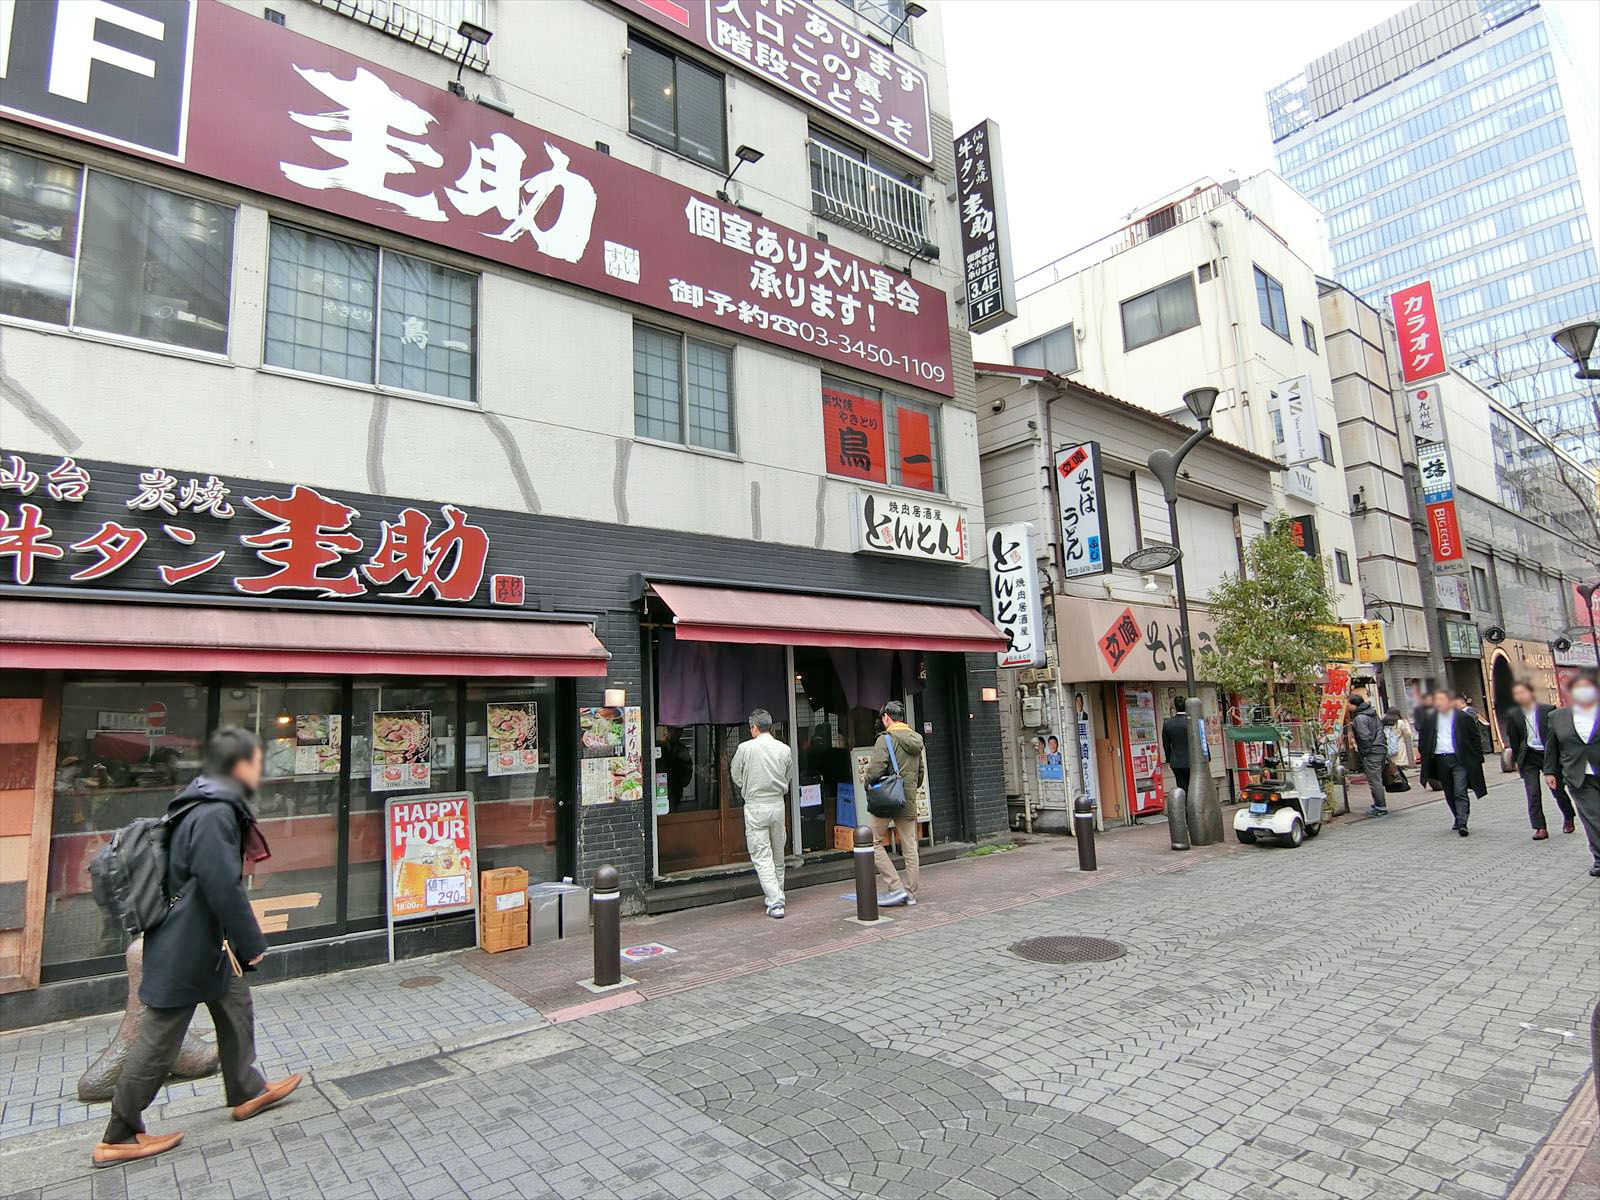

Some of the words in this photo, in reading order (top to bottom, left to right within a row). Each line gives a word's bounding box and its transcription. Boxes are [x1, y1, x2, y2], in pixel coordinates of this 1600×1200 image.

[716, 18, 913, 144] 階段でどうぞ
[279, 62, 598, 264] 圭助
[958, 137, 974, 195] 牛タン
[685, 196, 920, 316] 個室あり大小宴会
[323, 301, 373, 322] やきとり
[750, 261, 876, 332] 承ります!
[970, 274, 998, 299] 3.4F
[976, 297, 995, 318] 1F
[668, 278, 769, 331] 御予約
[799, 322, 946, 383] 03-3450-1109
[1402, 296, 1434, 371] カラオケ
[839, 411, 878, 430] やきとり
[1417, 402, 1434, 430] 九州桜
[127, 468, 236, 519] 炭焼
[888, 501, 943, 521] 焼肉居酒屋
[1076, 468, 1096, 516] そば
[0, 503, 226, 586] 牛タン
[234, 485, 490, 601] 圭助
[1063, 507, 1084, 561] うどん
[1434, 508, 1446, 528] BIG
[1440, 528, 1452, 557] ECHO
[1015, 578, 1029, 636] 焼肉居酒屋
[394, 800, 465, 823] HAPPY
[395, 819, 466, 847] HOUR
